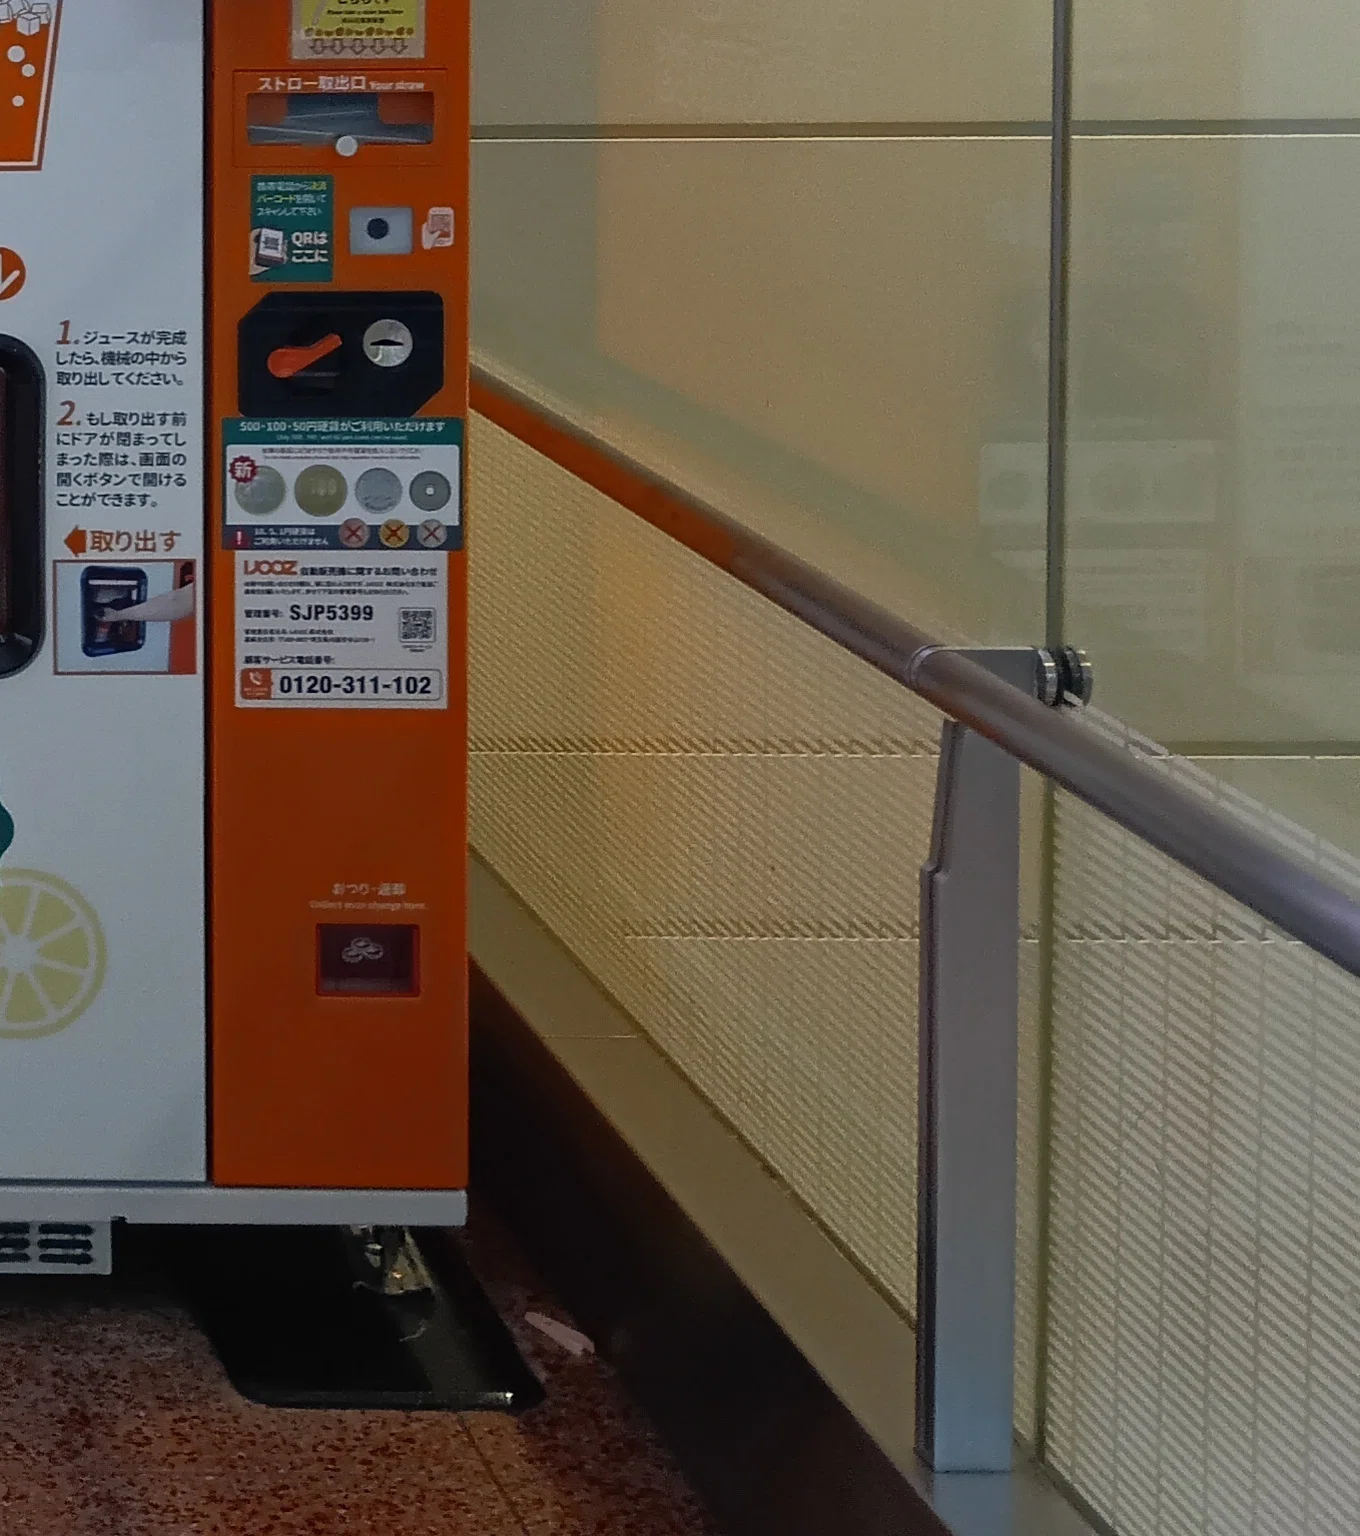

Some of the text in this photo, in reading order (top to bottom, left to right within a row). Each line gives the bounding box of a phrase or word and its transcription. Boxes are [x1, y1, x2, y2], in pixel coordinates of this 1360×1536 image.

[259, 75, 366, 91] ストロー取出口
[291, 231, 328, 248] QRは
[292, 249, 329, 263] ここに
[56, 319, 187, 345] 1. ジュースが完成
[56, 351, 187, 366] したら、機械の中から
[56, 371, 184, 386] 取り出してください。
[56, 400, 187, 426] 2. もし取り出す前
[56, 431, 187, 446] にドアが閉まってし
[56, 452, 187, 467] まった際は、画面の
[236, 461, 253, 479] 新
[56, 472, 187, 487] 開くボタンで開ける
[56, 492, 158, 508] ことができます。
[89, 529, 182, 553] 取り出す
[289, 604, 374, 621] SJP5399
[280, 675, 432, 694] 0120-311-102
